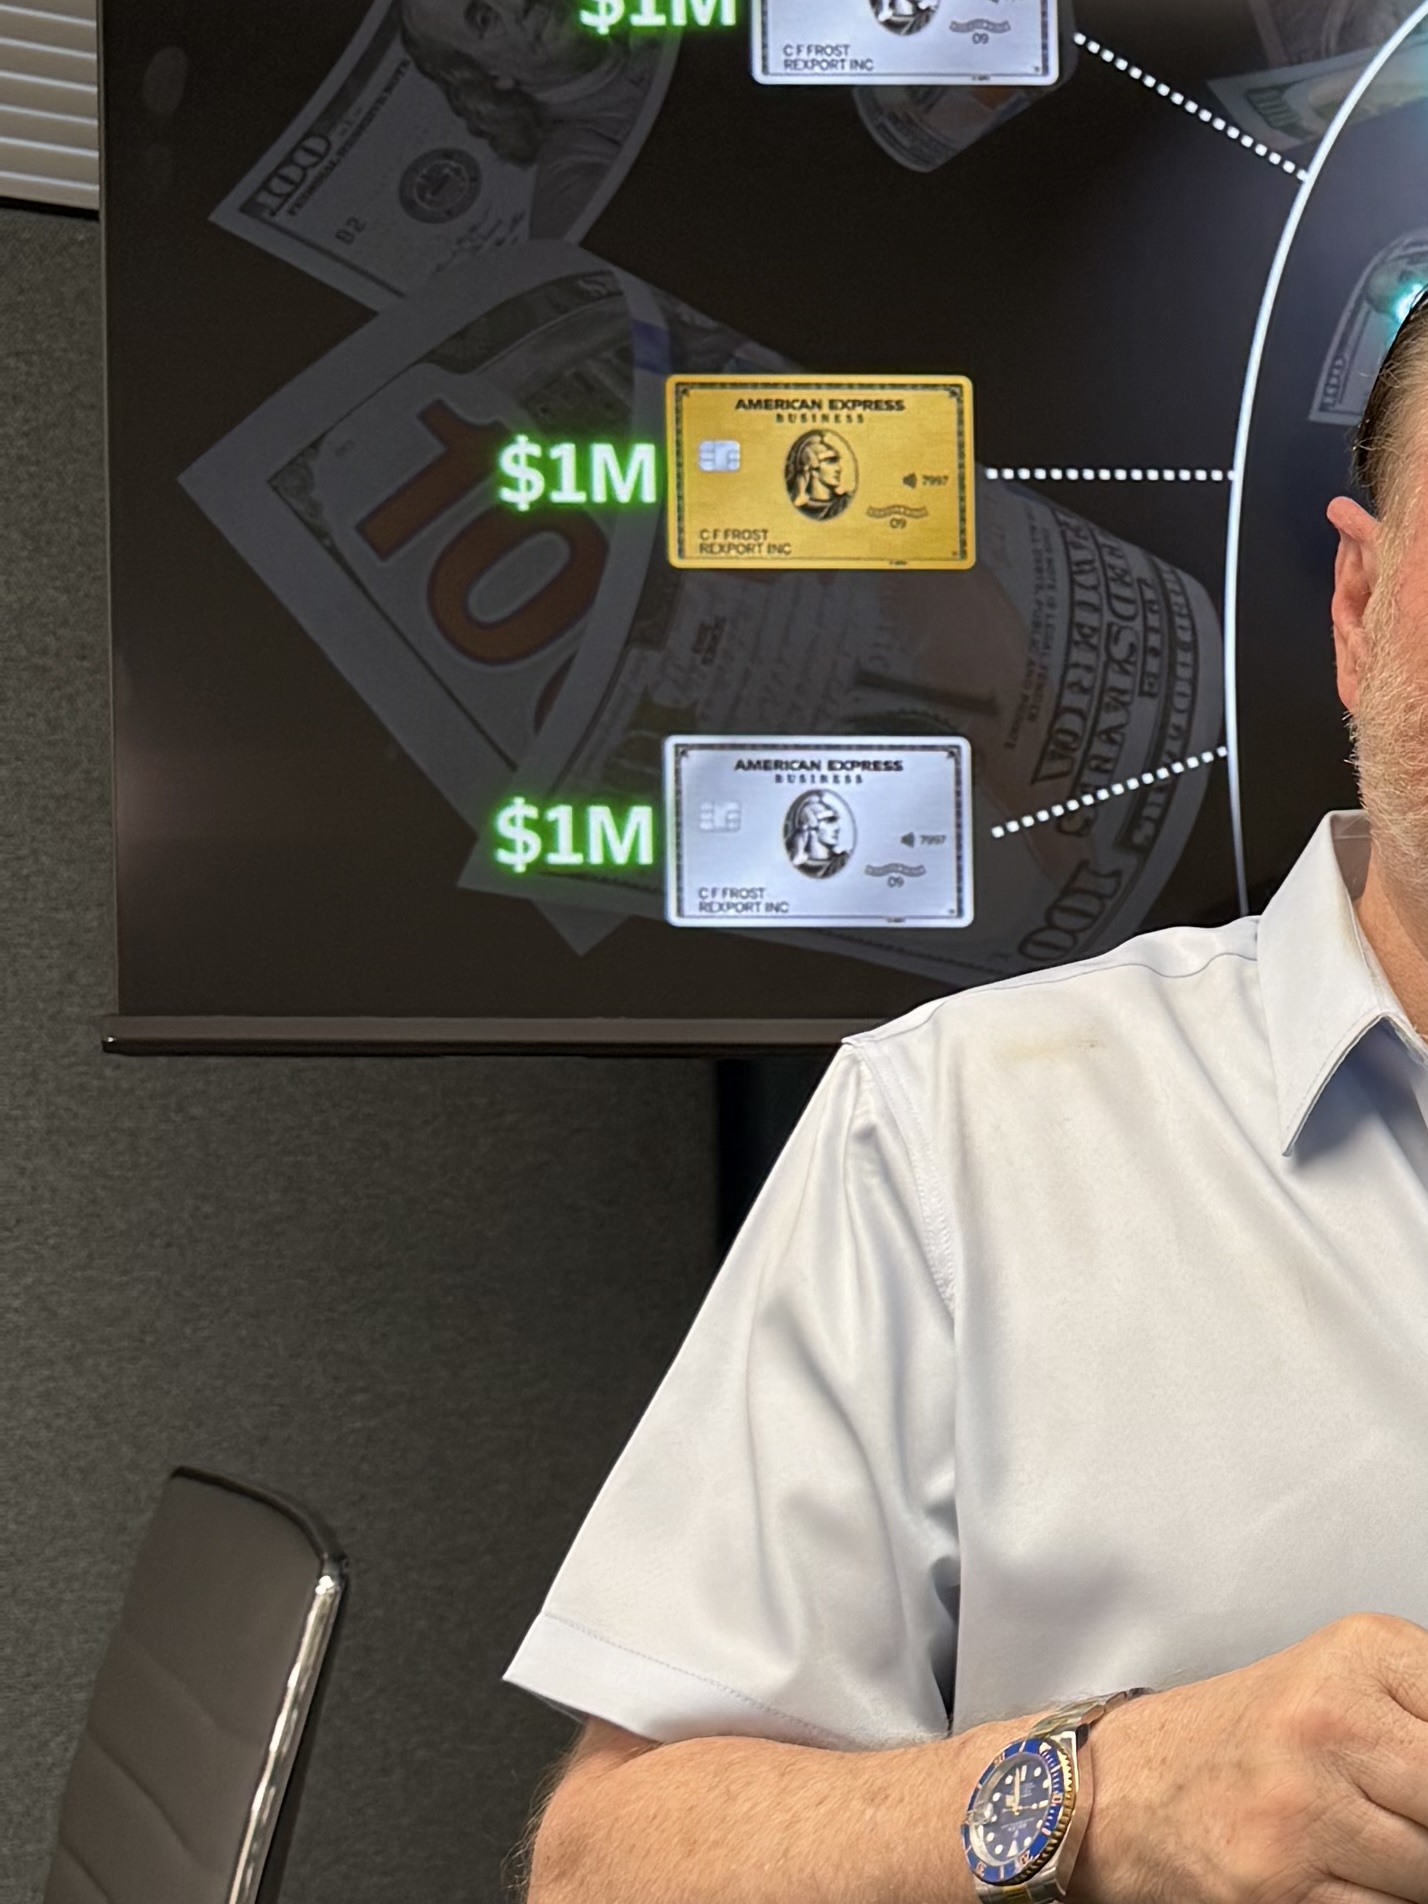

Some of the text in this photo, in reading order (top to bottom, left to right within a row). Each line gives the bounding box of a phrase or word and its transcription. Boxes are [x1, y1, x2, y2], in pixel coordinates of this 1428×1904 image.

[783, 44, 850, 58] C F FROST
[783, 59, 875, 72] REXPORT INC
[735, 399, 906, 411] AMERICAN EXPRESS
[776, 413, 864, 424] BUSINESS
[498, 435, 657, 511] $1M
[700, 529, 769, 541] C F FROST
[699, 543, 792, 555] REXPORT INC
[734, 759, 904, 772] AMERICAN EXPRESS
[775, 774, 863, 784] BUSINESS
[495, 798, 655, 873] $1M
[698, 887, 766, 900] C F FROST
[699, 901, 789, 914] REXPORT INC
